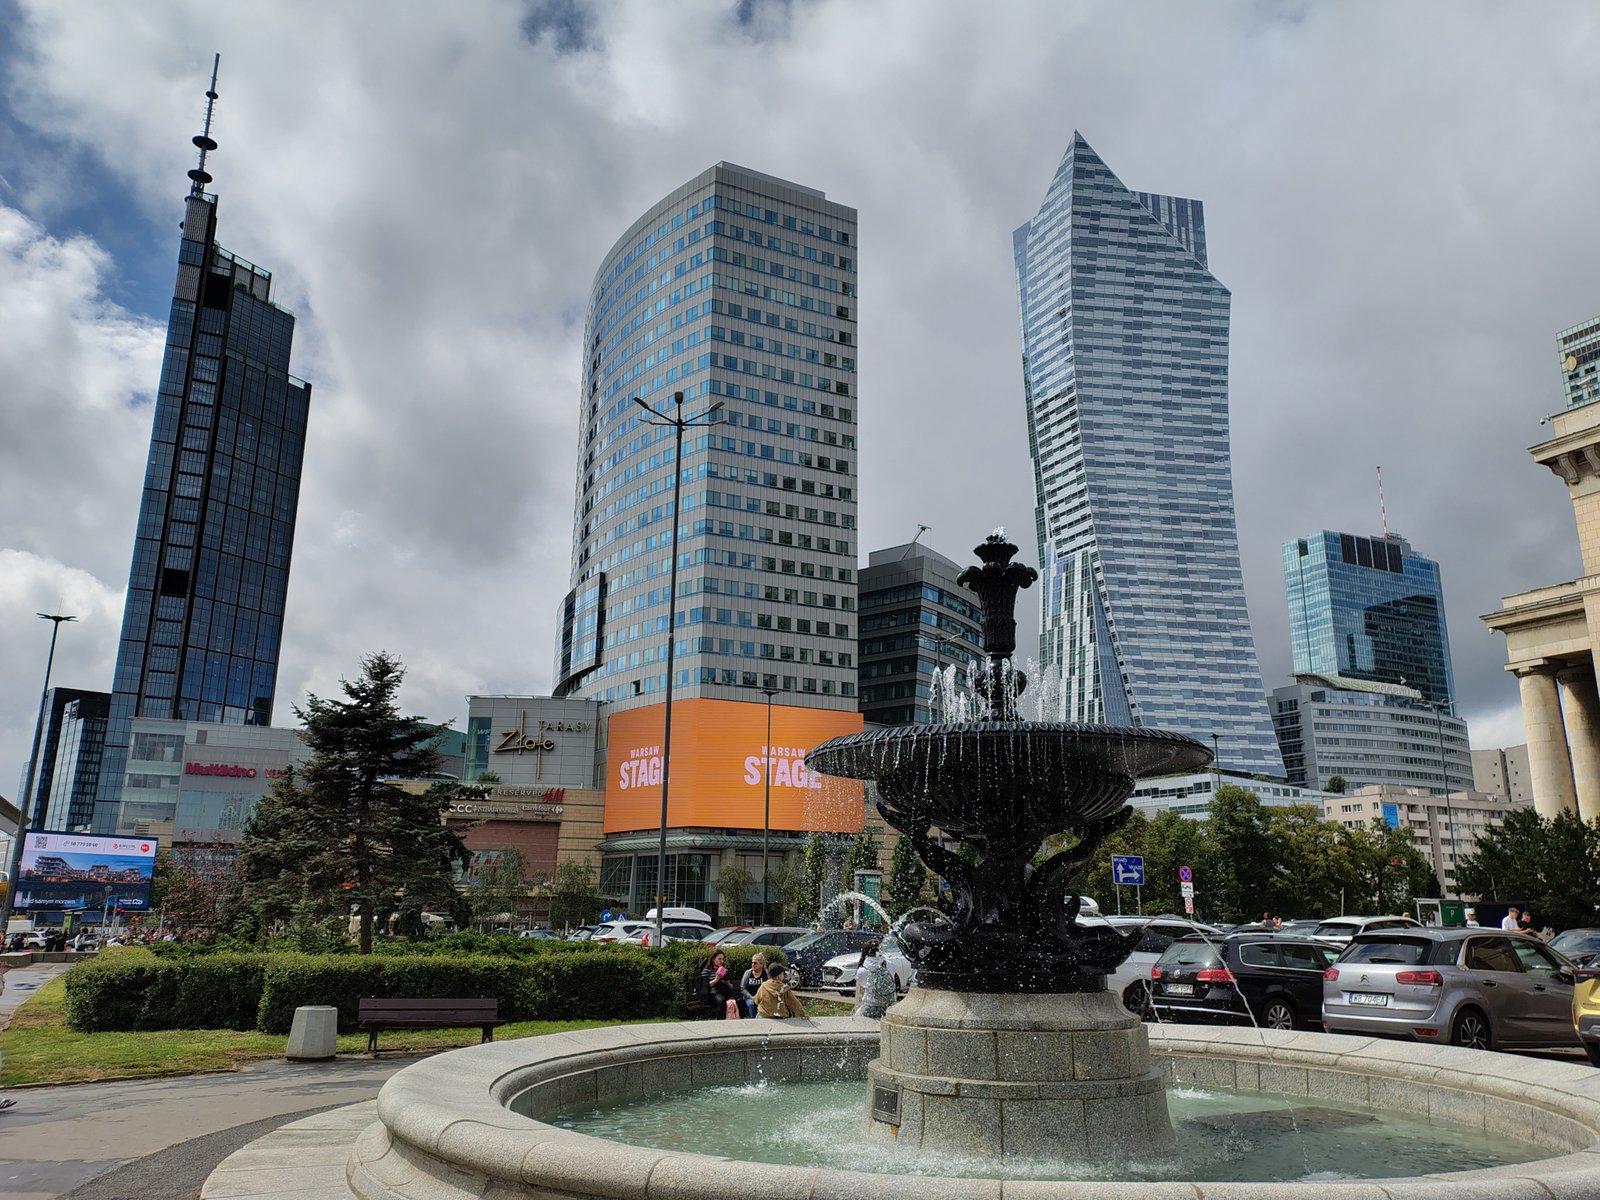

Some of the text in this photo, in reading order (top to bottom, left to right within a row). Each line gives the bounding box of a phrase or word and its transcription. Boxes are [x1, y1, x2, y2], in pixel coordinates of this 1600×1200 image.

[538, 720, 592, 733] TARASY
[630, 745, 659, 758] WARSAW
[761, 745, 806, 757] WARSAW
[185, 762, 257, 778] Multikino
[497, 788, 542, 797] RESERVED
[542, 787, 566, 802] H&M
[448, 804, 473, 813] CCC
